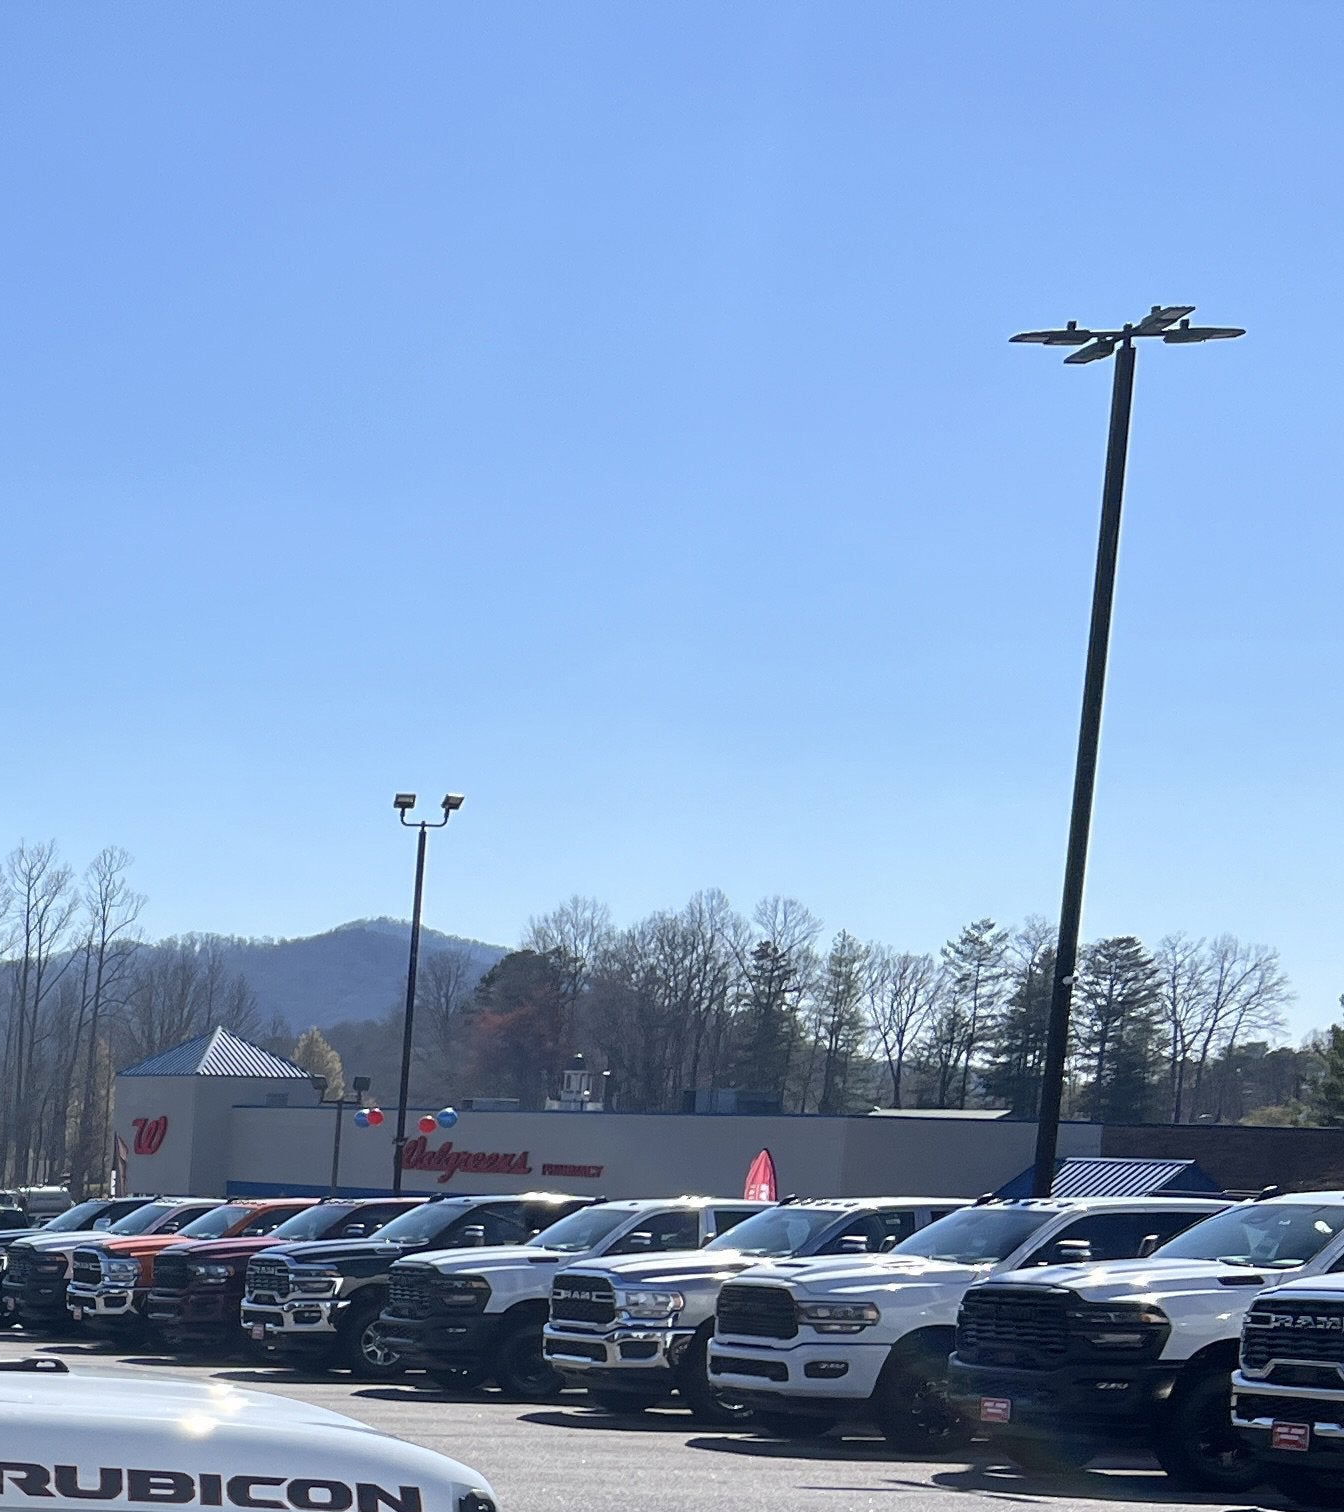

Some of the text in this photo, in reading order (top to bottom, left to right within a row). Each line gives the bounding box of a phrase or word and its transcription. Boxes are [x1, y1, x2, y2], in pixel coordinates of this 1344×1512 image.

[132, 1115, 168, 1155] W
[561, 1290, 591, 1300] RAM
[1273, 1314, 1342, 1329] RAM
